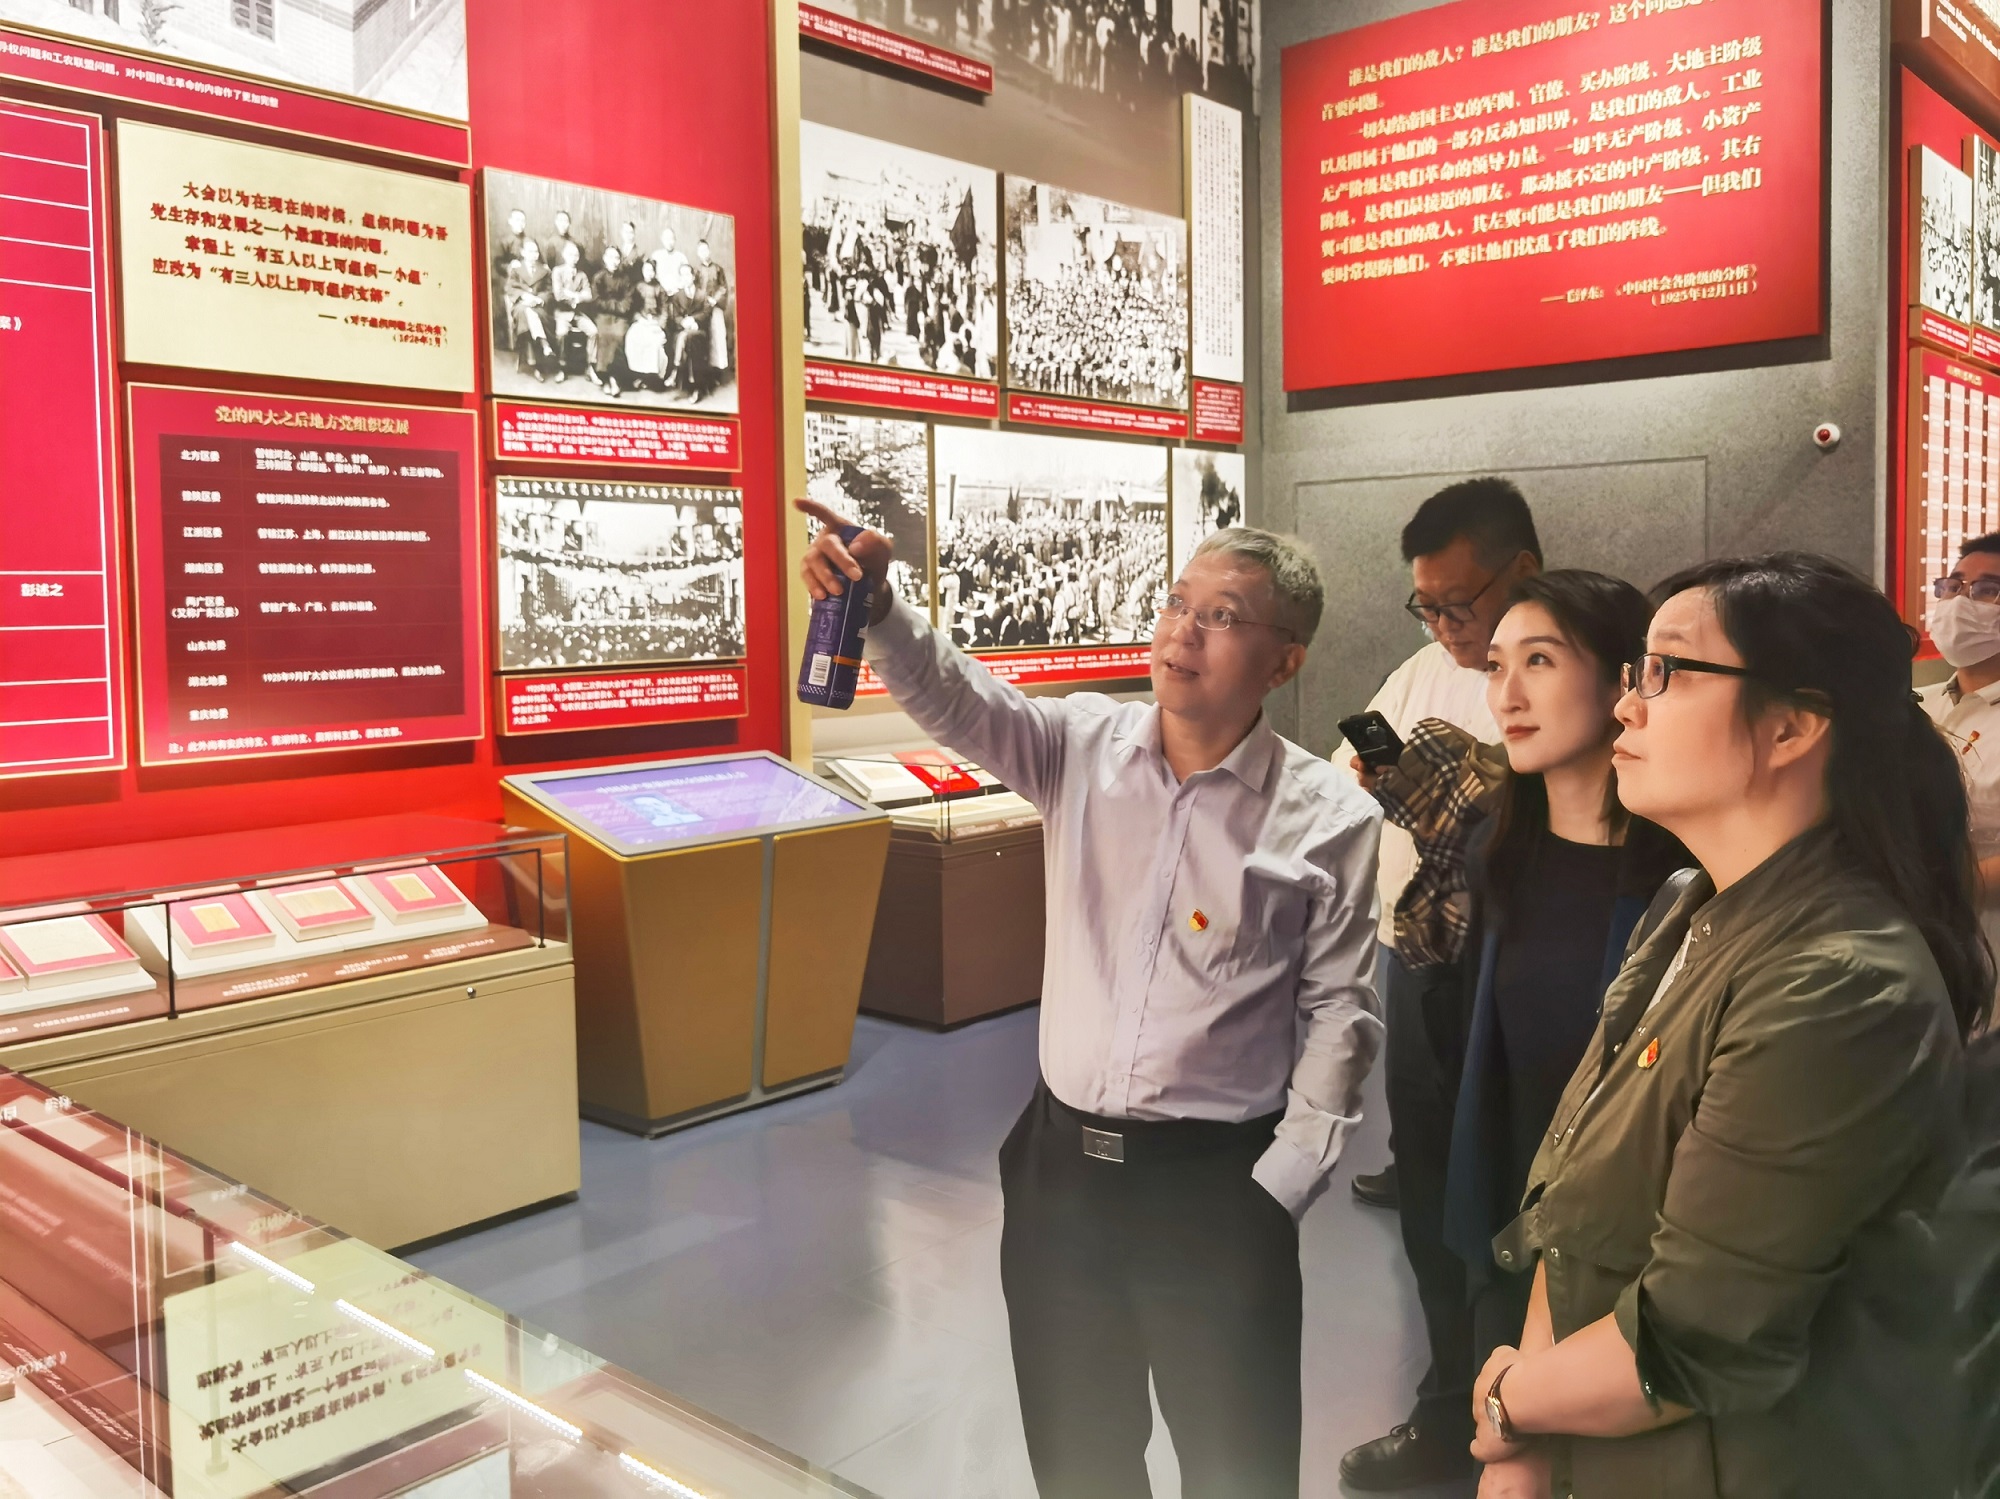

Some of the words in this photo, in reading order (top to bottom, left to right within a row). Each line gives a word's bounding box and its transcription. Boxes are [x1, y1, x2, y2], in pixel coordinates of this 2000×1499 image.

[1320, 68, 1763, 175] 以及附属于他们的一部分反动知识界，是我们的敌人。工业
[1321, 102, 1762, 203] 无产阶级是我们革命的领导力量。一切半无产阶级、小资产
[150, 202, 389, 256] 党生存和发展之一个最重要的问题。
[1320, 135, 1761, 232] 阶级，是我们最接近的朋友。那动摇不定的中产阶级，其右
[214, 404, 411, 436] 党的四大之后地方党组织发展
